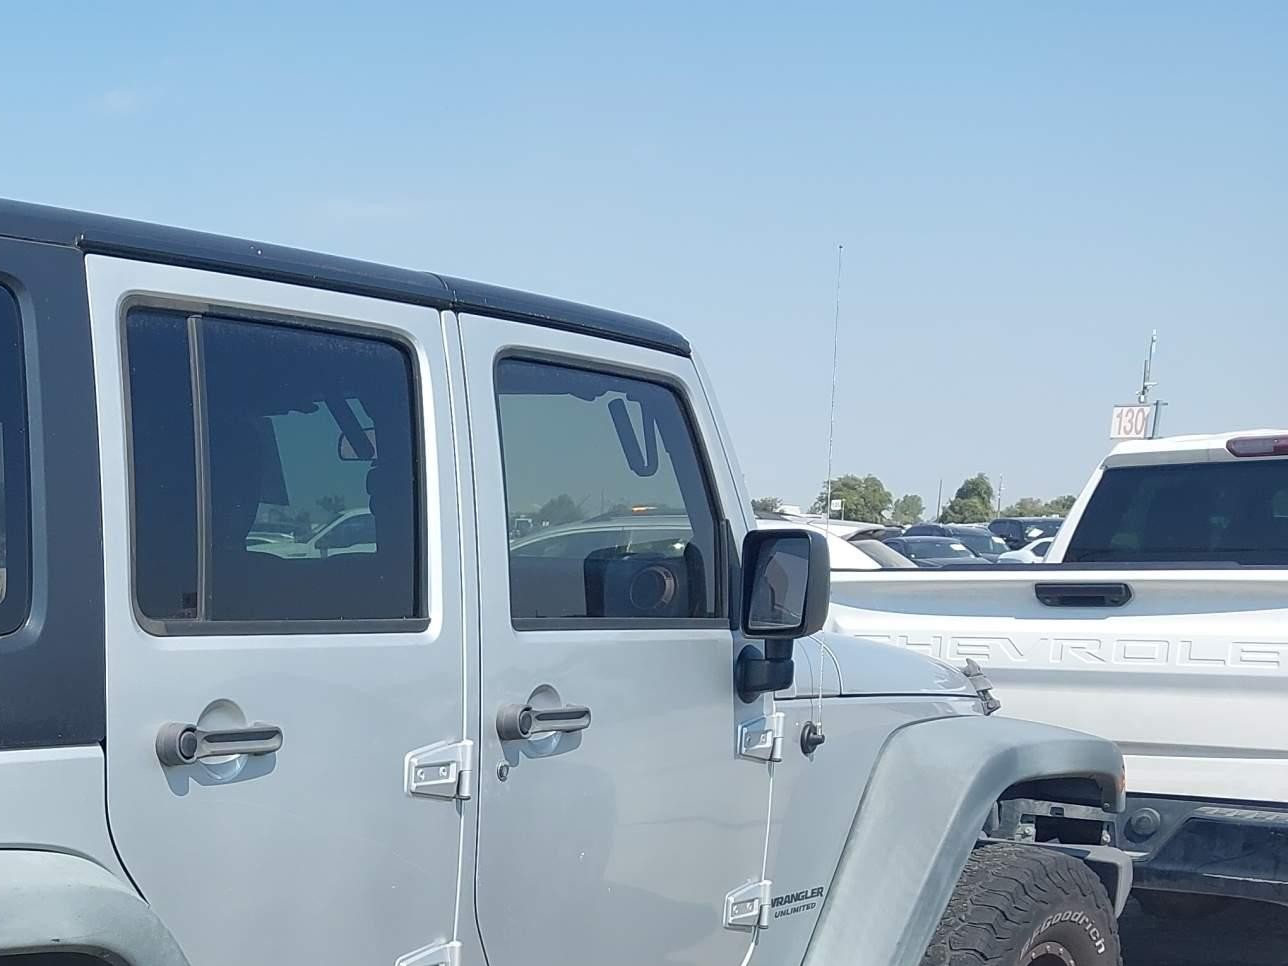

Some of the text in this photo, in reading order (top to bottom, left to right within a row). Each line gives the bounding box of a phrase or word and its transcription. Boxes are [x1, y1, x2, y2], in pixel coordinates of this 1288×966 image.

[1116, 408, 1145, 435] 130
[854, 634, 1288, 668] HEVROLE
[775, 902, 816, 918] UNLIMITED
[1020, 908, 1105, 960] BFGoodrich
